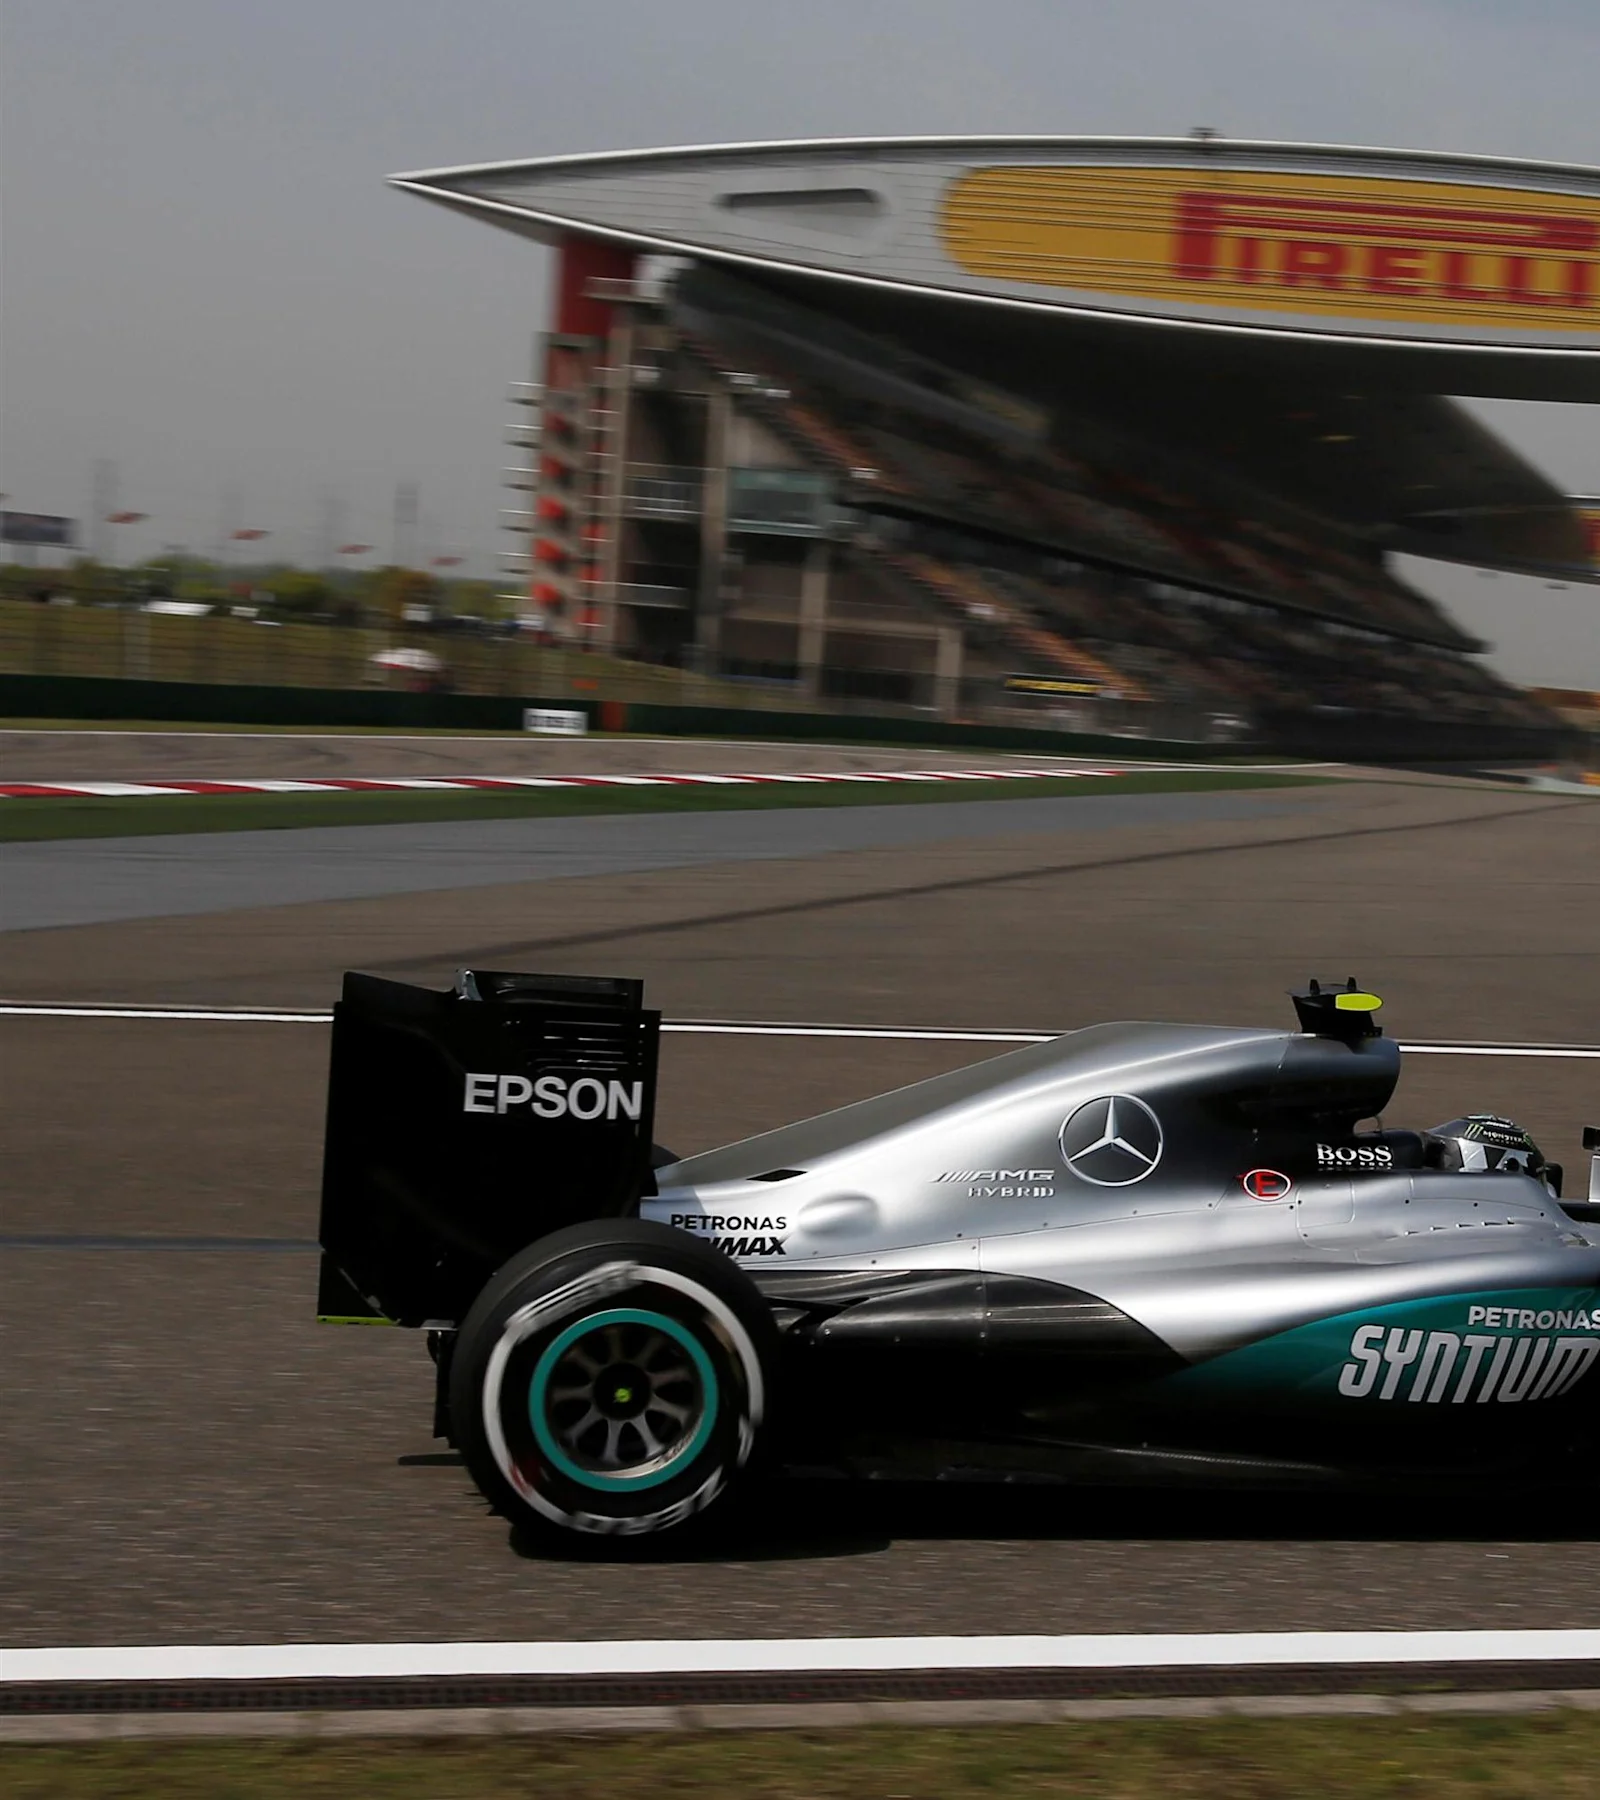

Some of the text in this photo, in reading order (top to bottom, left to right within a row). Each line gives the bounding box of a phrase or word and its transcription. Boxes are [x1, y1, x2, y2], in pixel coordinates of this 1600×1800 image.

[463, 1072, 644, 1120] EPSON
[1316, 1143, 1393, 1163] BOSS
[968, 1186, 1055, 1198] HYBRID
[1253, 1170, 1280, 1198] E
[671, 1214, 787, 1230] PETRONAS
